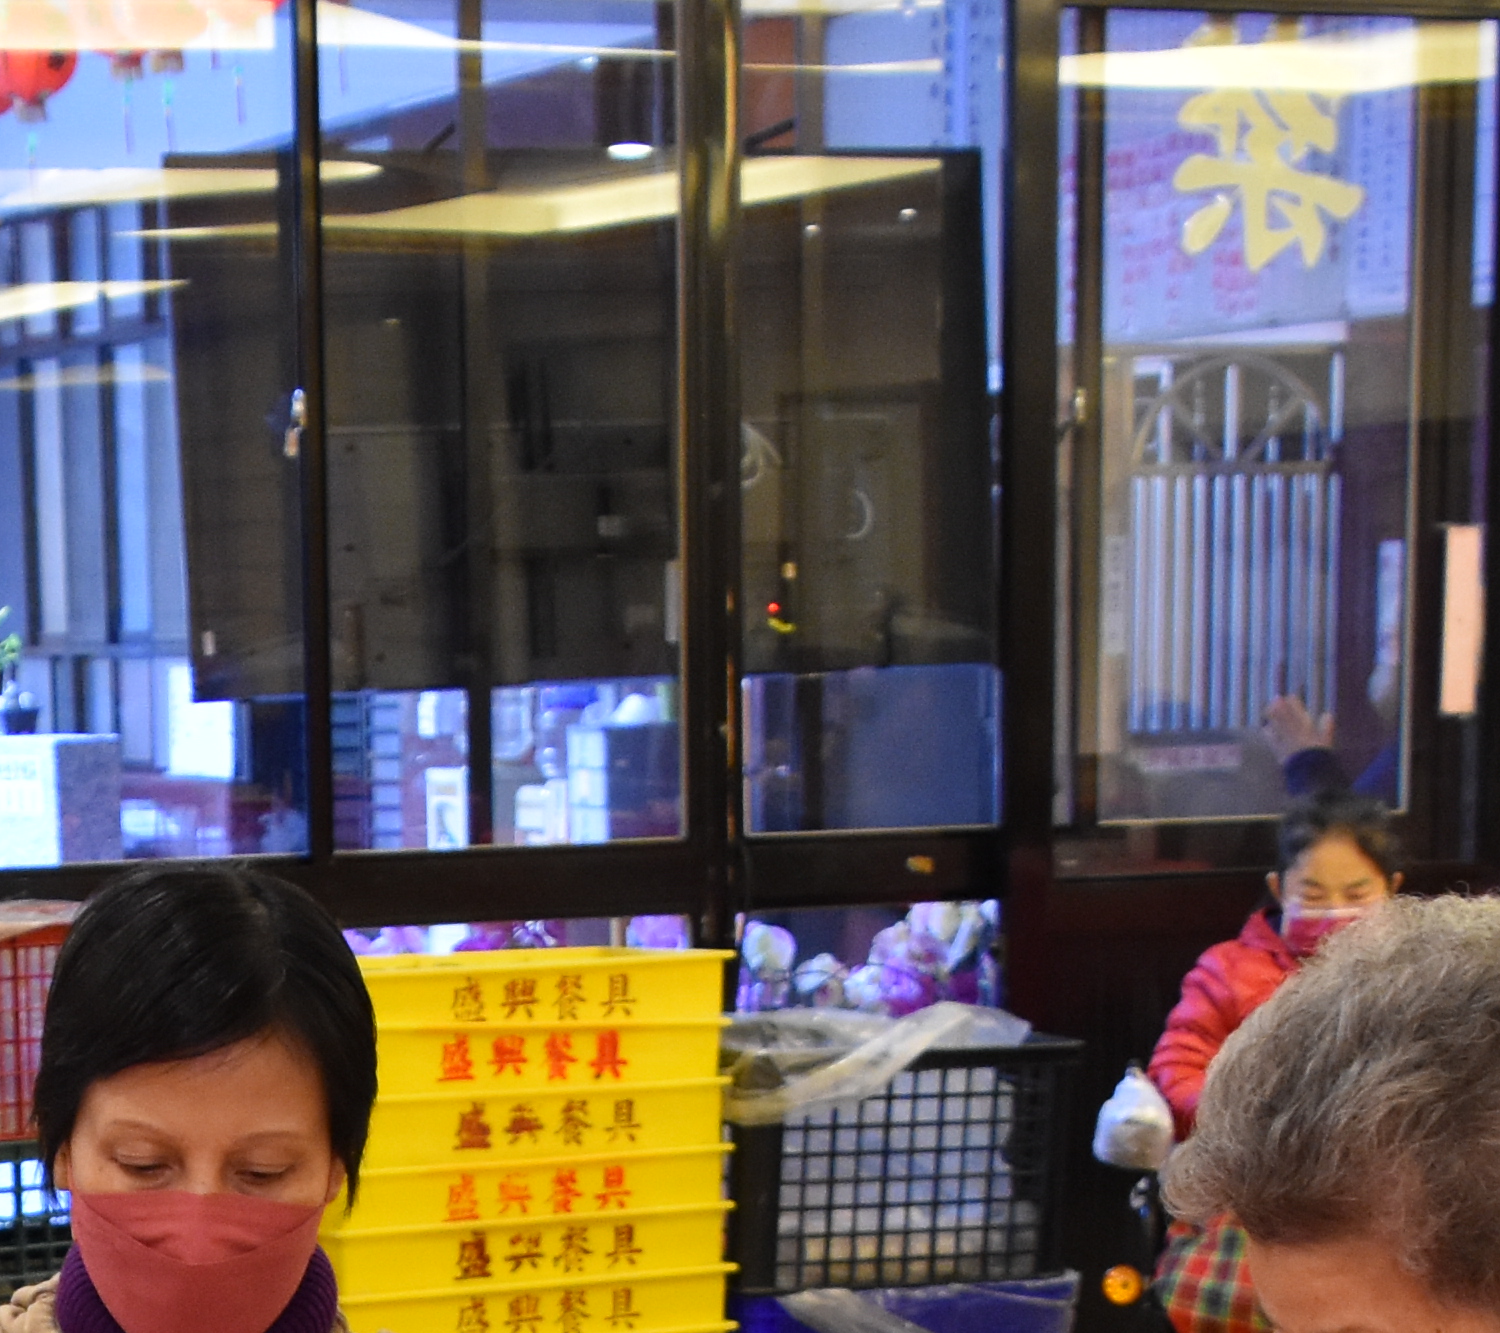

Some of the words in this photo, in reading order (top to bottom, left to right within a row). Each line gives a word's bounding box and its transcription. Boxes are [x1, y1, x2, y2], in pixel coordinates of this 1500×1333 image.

[452, 973, 637, 1022] 盛興餐具
[438, 1029, 629, 1081] 盛興餐具
[453, 1098, 641, 1151] 盛興餐具
[444, 1165, 632, 1222] 盛興餐具
[454, 1223, 643, 1280] 盛興餐具
